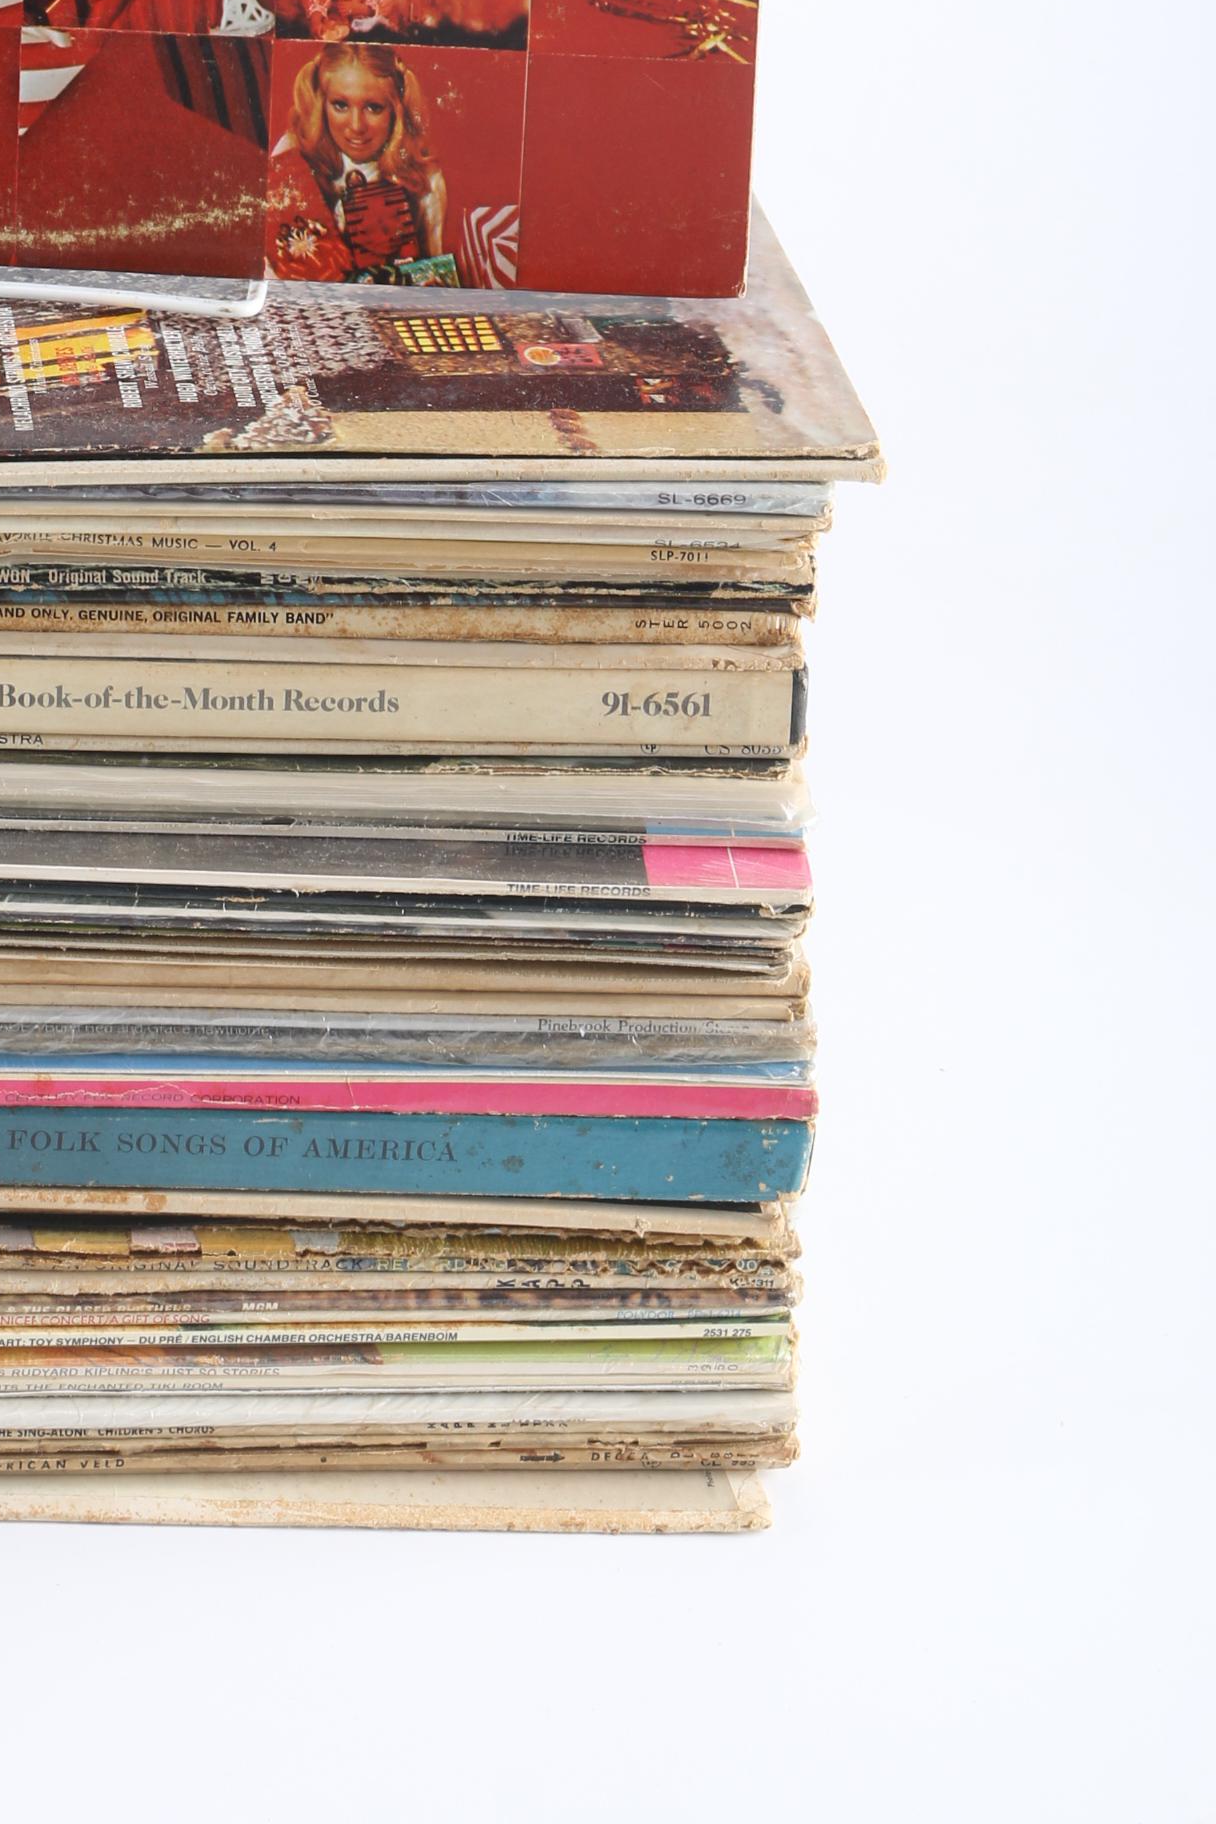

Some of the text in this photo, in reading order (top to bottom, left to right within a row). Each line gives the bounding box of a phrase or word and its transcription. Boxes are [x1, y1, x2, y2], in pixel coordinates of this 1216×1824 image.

[163, 330, 199, 403] HUGO WINTERHALTER
[120, 381, 143, 408] ROBERT
[658, 493, 747, 506] SL-6669
[57, 533, 143, 547] CHRISTMAS
[152, 537, 199, 550] MUSIC
[229, 540, 262, 552] VOL.
[269, 540, 277, 552] 4
[48, 569, 107, 585] Original
[112, 570, 159, 584] Sound
[164, 570, 208, 584] Track
[31, 608, 73, 621] ONLY,
[78, 609, 149, 624] GENUINE,
[153, 610, 221, 624] ORIGINAL
[228, 611, 280, 624] FAMILY
[635, 619, 752, 631] STER 5002
[282, 688, 400, 713] Records
[601, 692, 712, 718] 91-6561
[505, 832, 572, 843] TIME-LIFE
[577, 834, 648, 845] RECORDS
[507, 884, 576, 895] TIME-LIFE
[580, 885, 651, 897] RECORDS
[537, 1018, 611, 1033] Pinebrook
[7, 1129, 458, 1163] FOLK SONGS OF AMERICA
[173, 1313, 210, 1324] SONG
[28, 1337, 53, 1347] TOY
[56, 1336, 125, 1346] SYMPHONY
[139, 1335, 156, 1344] DU
[191, 1335, 243, 1344] ENGLISH
[247, 1334, 305, 1343] CHAMBER
[703, 1328, 729, 1337] 2531
[733, 1328, 752, 1337] 275
